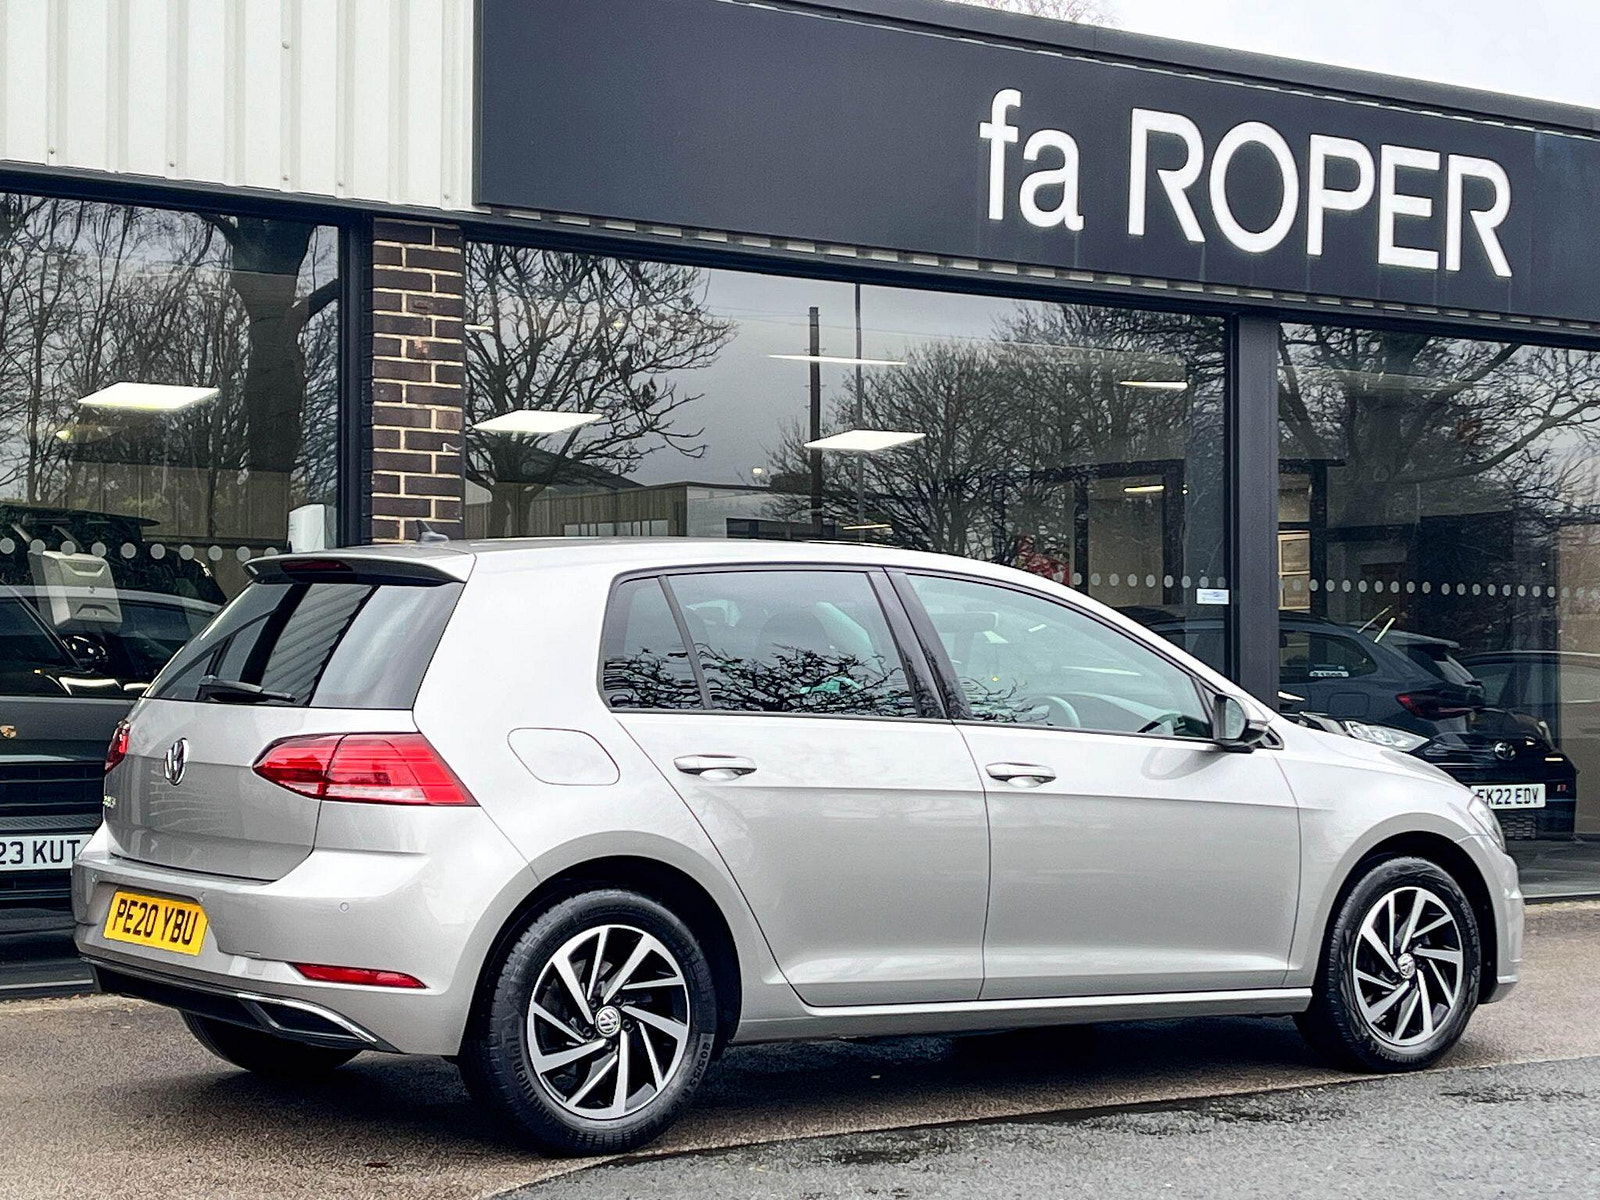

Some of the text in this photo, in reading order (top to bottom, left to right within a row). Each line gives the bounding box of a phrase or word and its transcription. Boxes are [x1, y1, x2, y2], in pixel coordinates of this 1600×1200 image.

[979, 89, 1512, 278] fa ROPER
[32, 839, 81, 865] KUT
[112, 898, 200, 946] PE20 YBU
